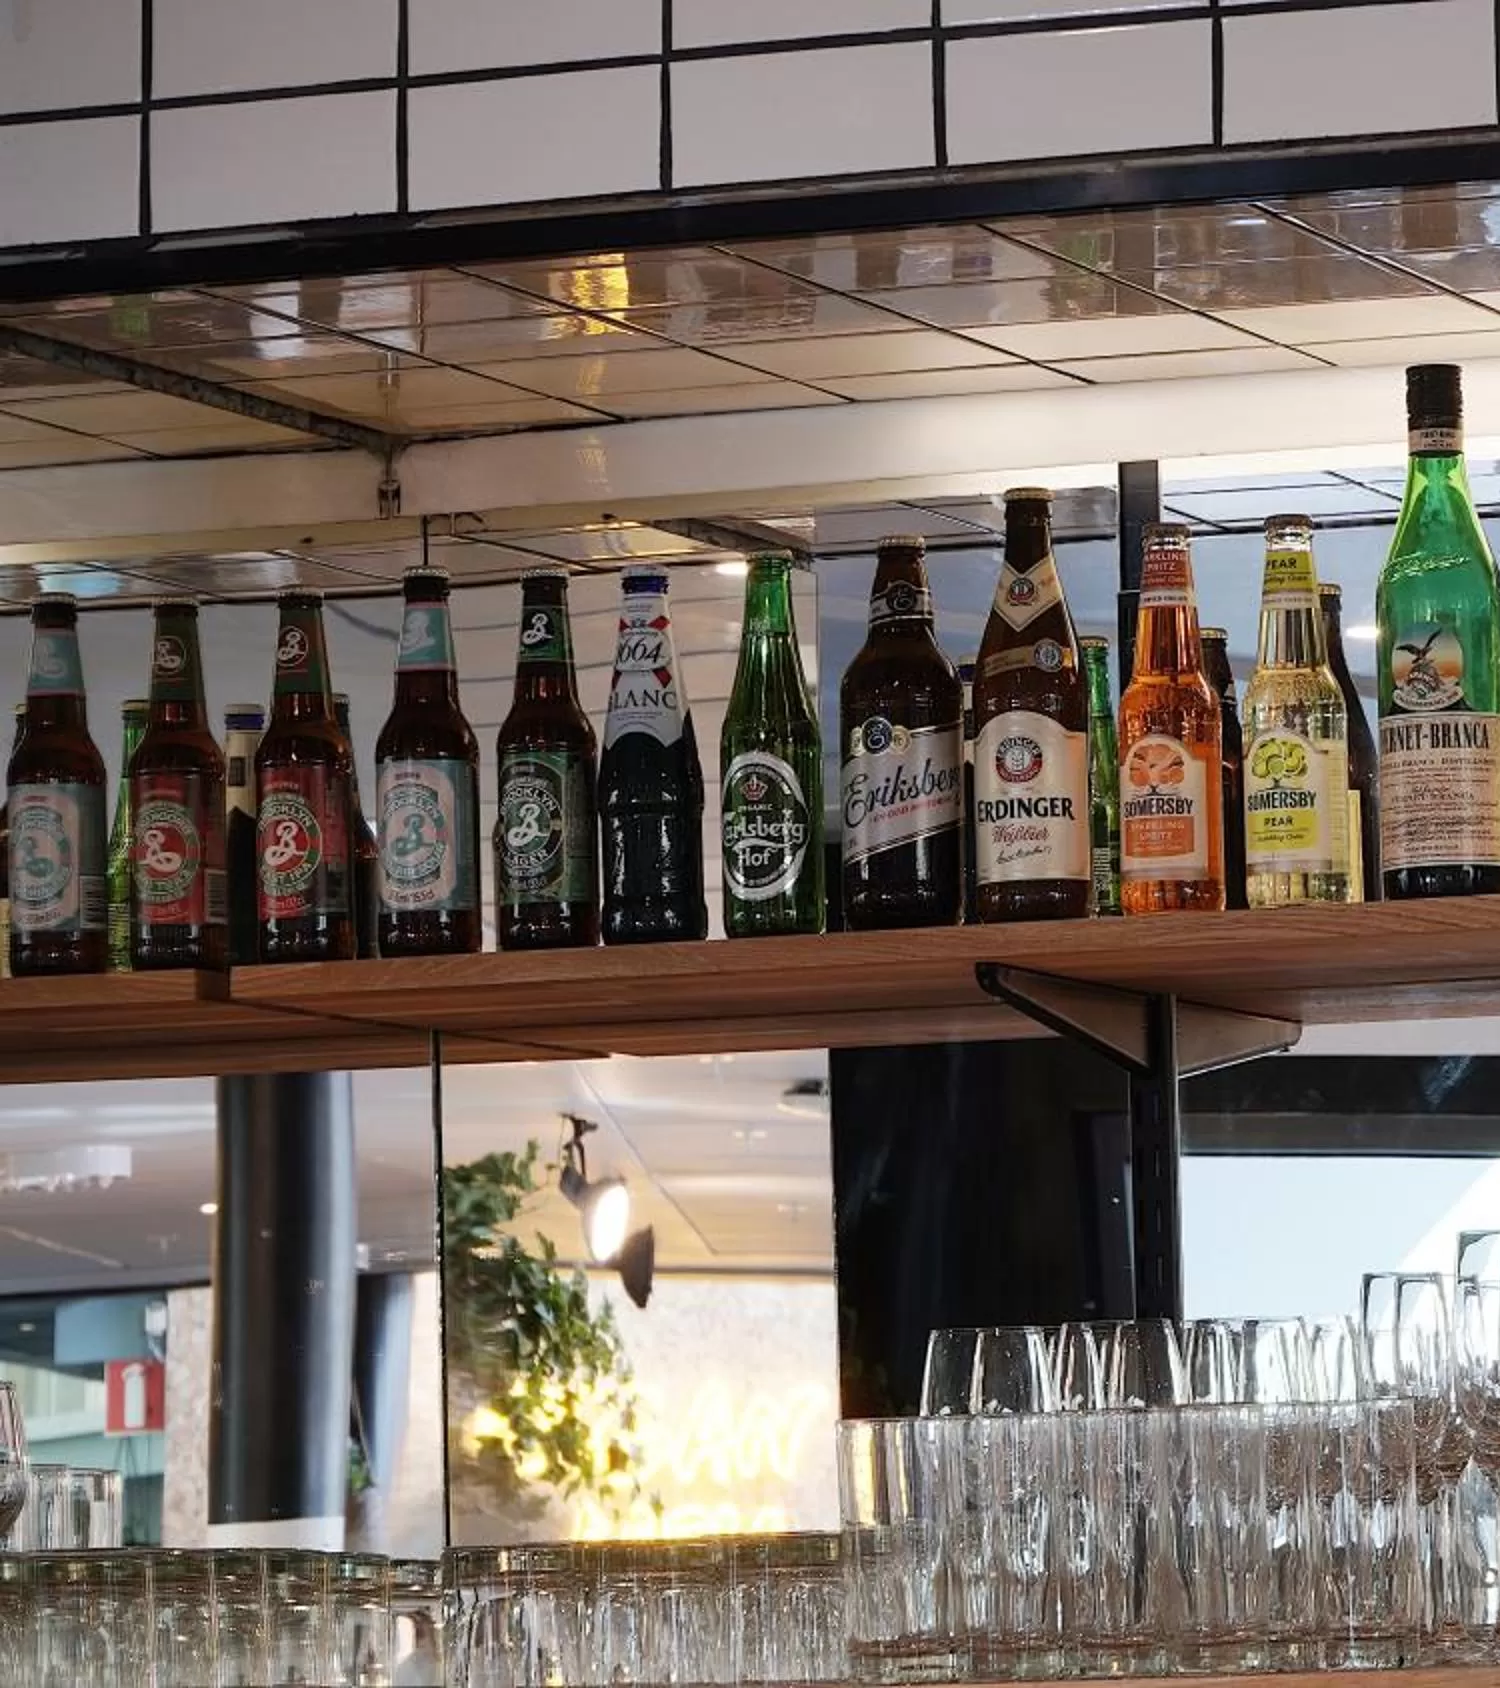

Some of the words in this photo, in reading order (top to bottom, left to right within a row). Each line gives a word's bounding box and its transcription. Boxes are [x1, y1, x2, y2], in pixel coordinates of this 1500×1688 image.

[976, 797, 1076, 823] ERDINGER
[1123, 797, 1193, 819] SOMERSBY
[1248, 789, 1317, 812] SOMERSBY
[1264, 815, 1294, 827] PEAR
